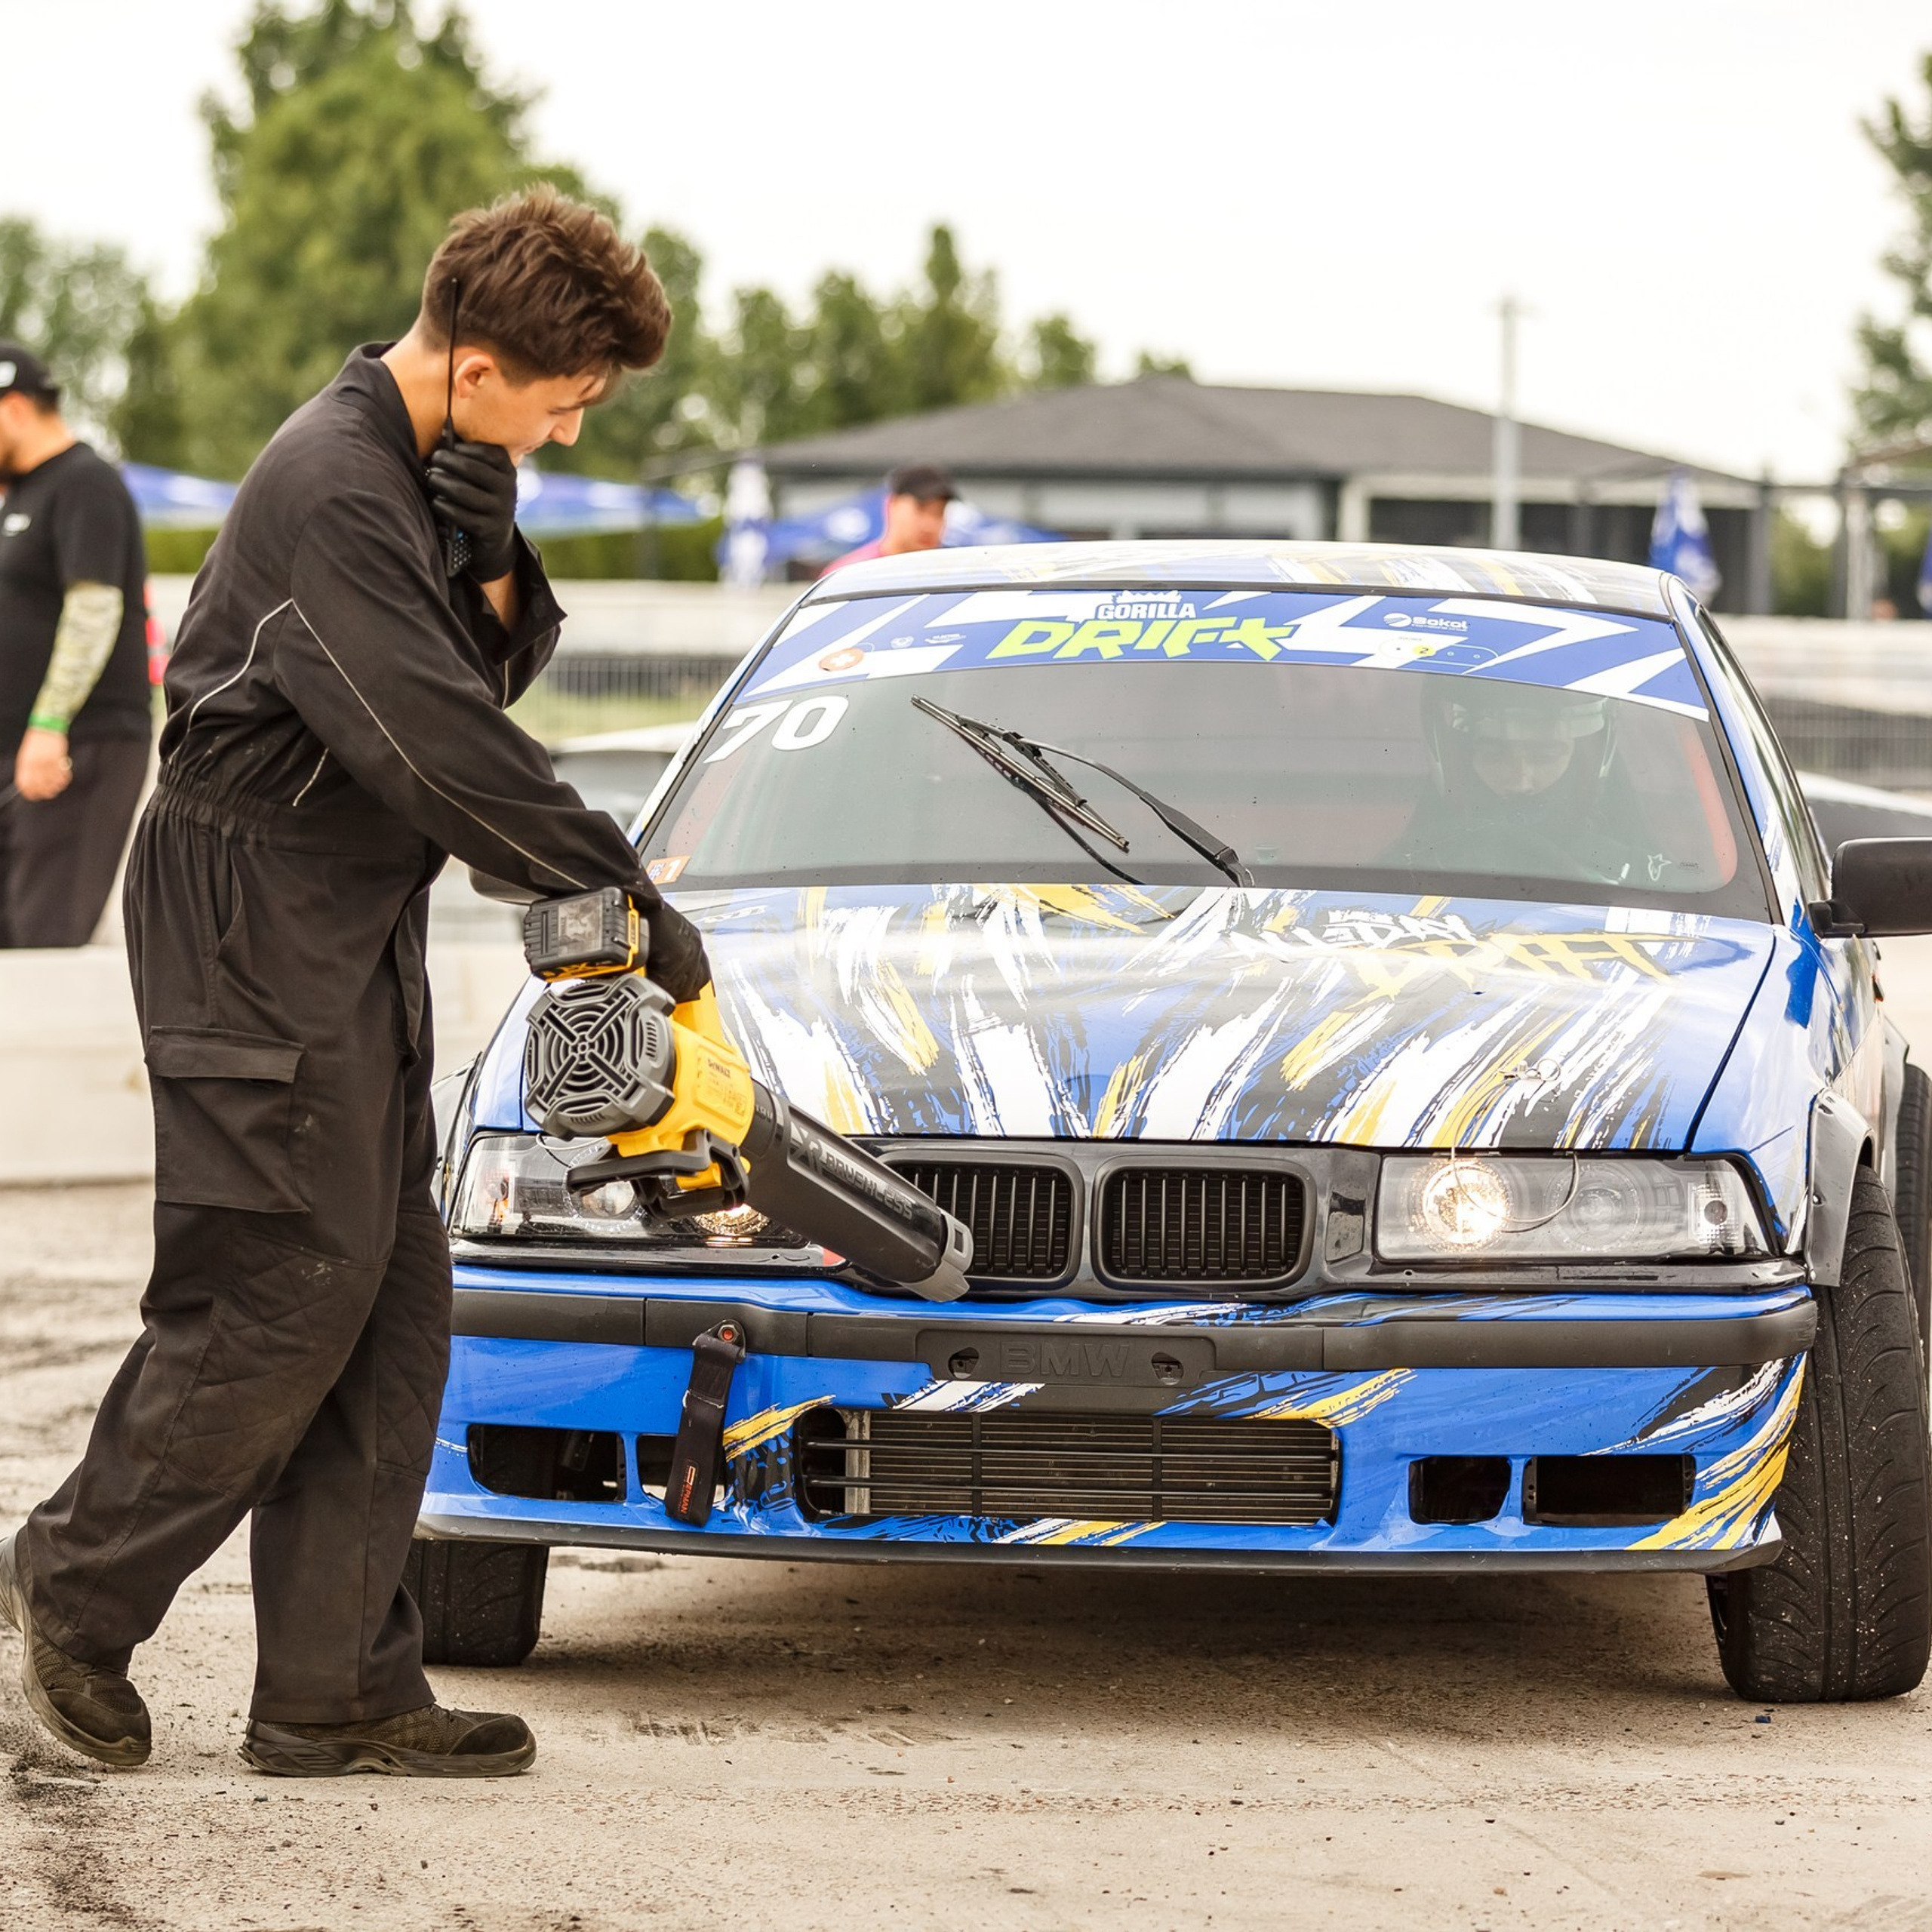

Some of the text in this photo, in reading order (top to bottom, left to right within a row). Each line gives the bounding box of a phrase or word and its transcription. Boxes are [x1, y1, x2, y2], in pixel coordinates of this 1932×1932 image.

[1097, 603, 1196, 620] GORILLA
[1412, 616, 1469, 630] Sokol
[985, 617, 1294, 661] DRIFT
[1419, 647, 1429, 655] 2
[703, 695, 849, 764] 70
[664, 858, 682, 881] 1
[825, 1152, 913, 1221] BRUSHLESS
[1000, 1340, 1131, 1378] BMW
